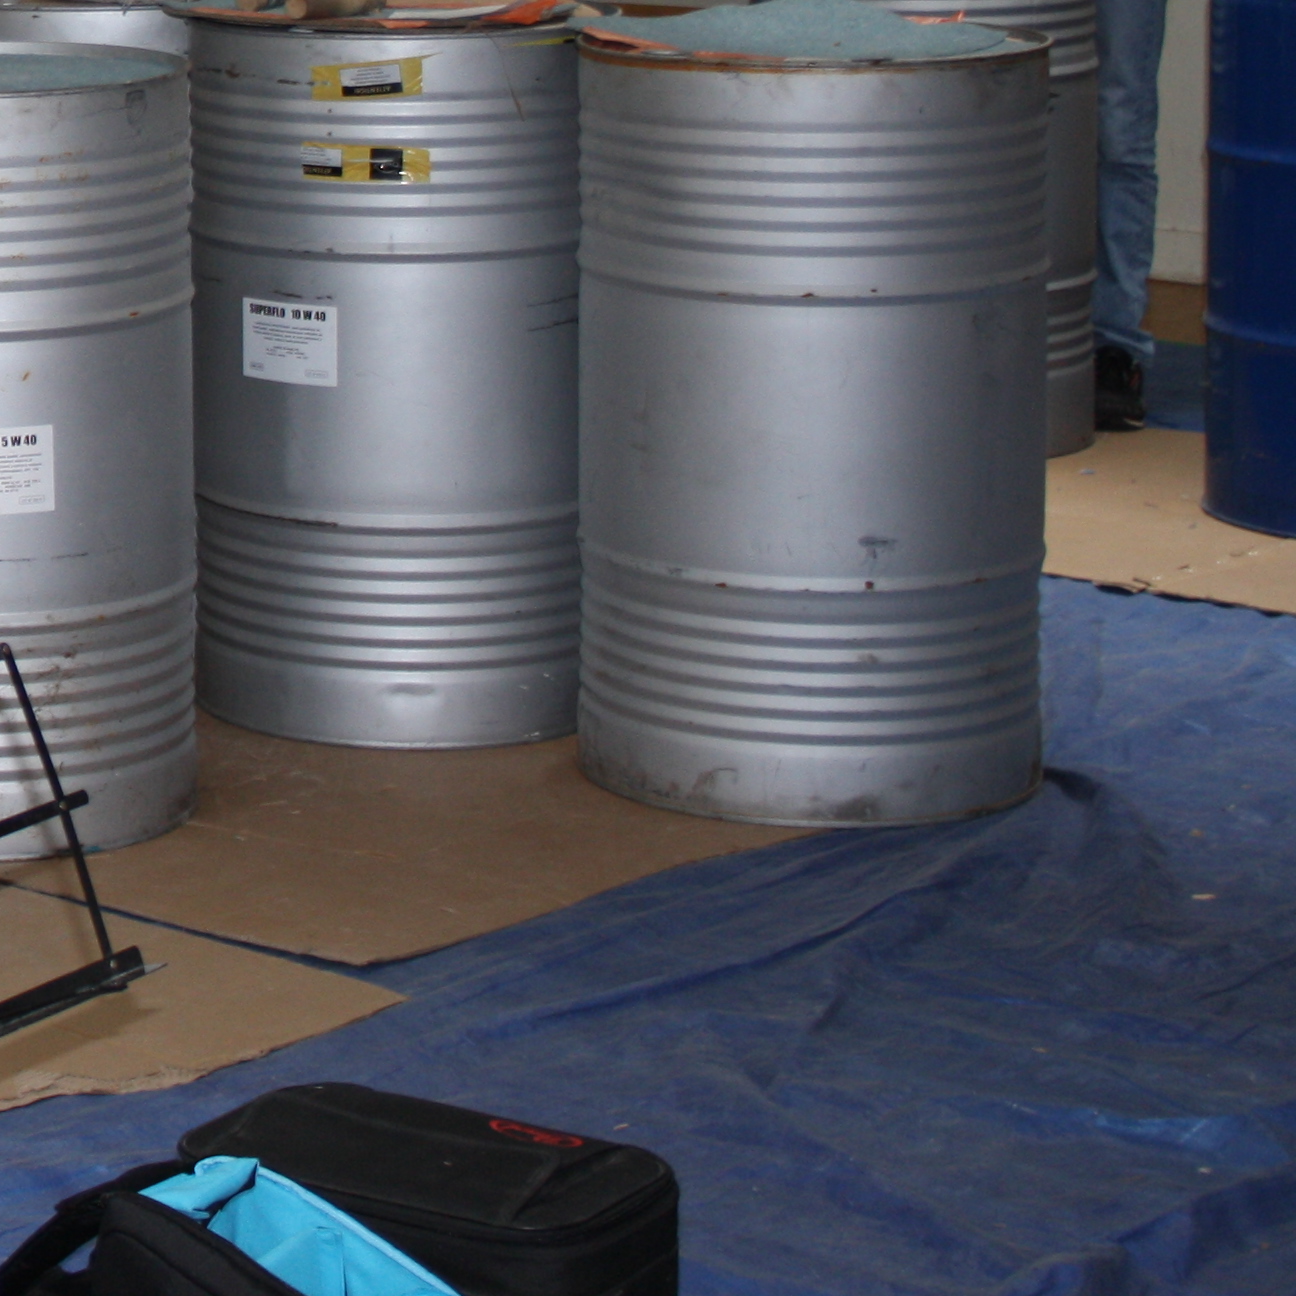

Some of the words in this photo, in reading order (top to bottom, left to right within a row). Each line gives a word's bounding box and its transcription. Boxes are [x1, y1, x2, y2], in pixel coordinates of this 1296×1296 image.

[249, 303, 286, 318] SUPERFLO
[291, 309, 301, 320] 10
[303, 310, 313, 321] W
[314, 311, 326, 322] 40
[1, 436, 9, 447] 5
[10, 435, 21, 447] W
[23, 434, 37, 446] 40
